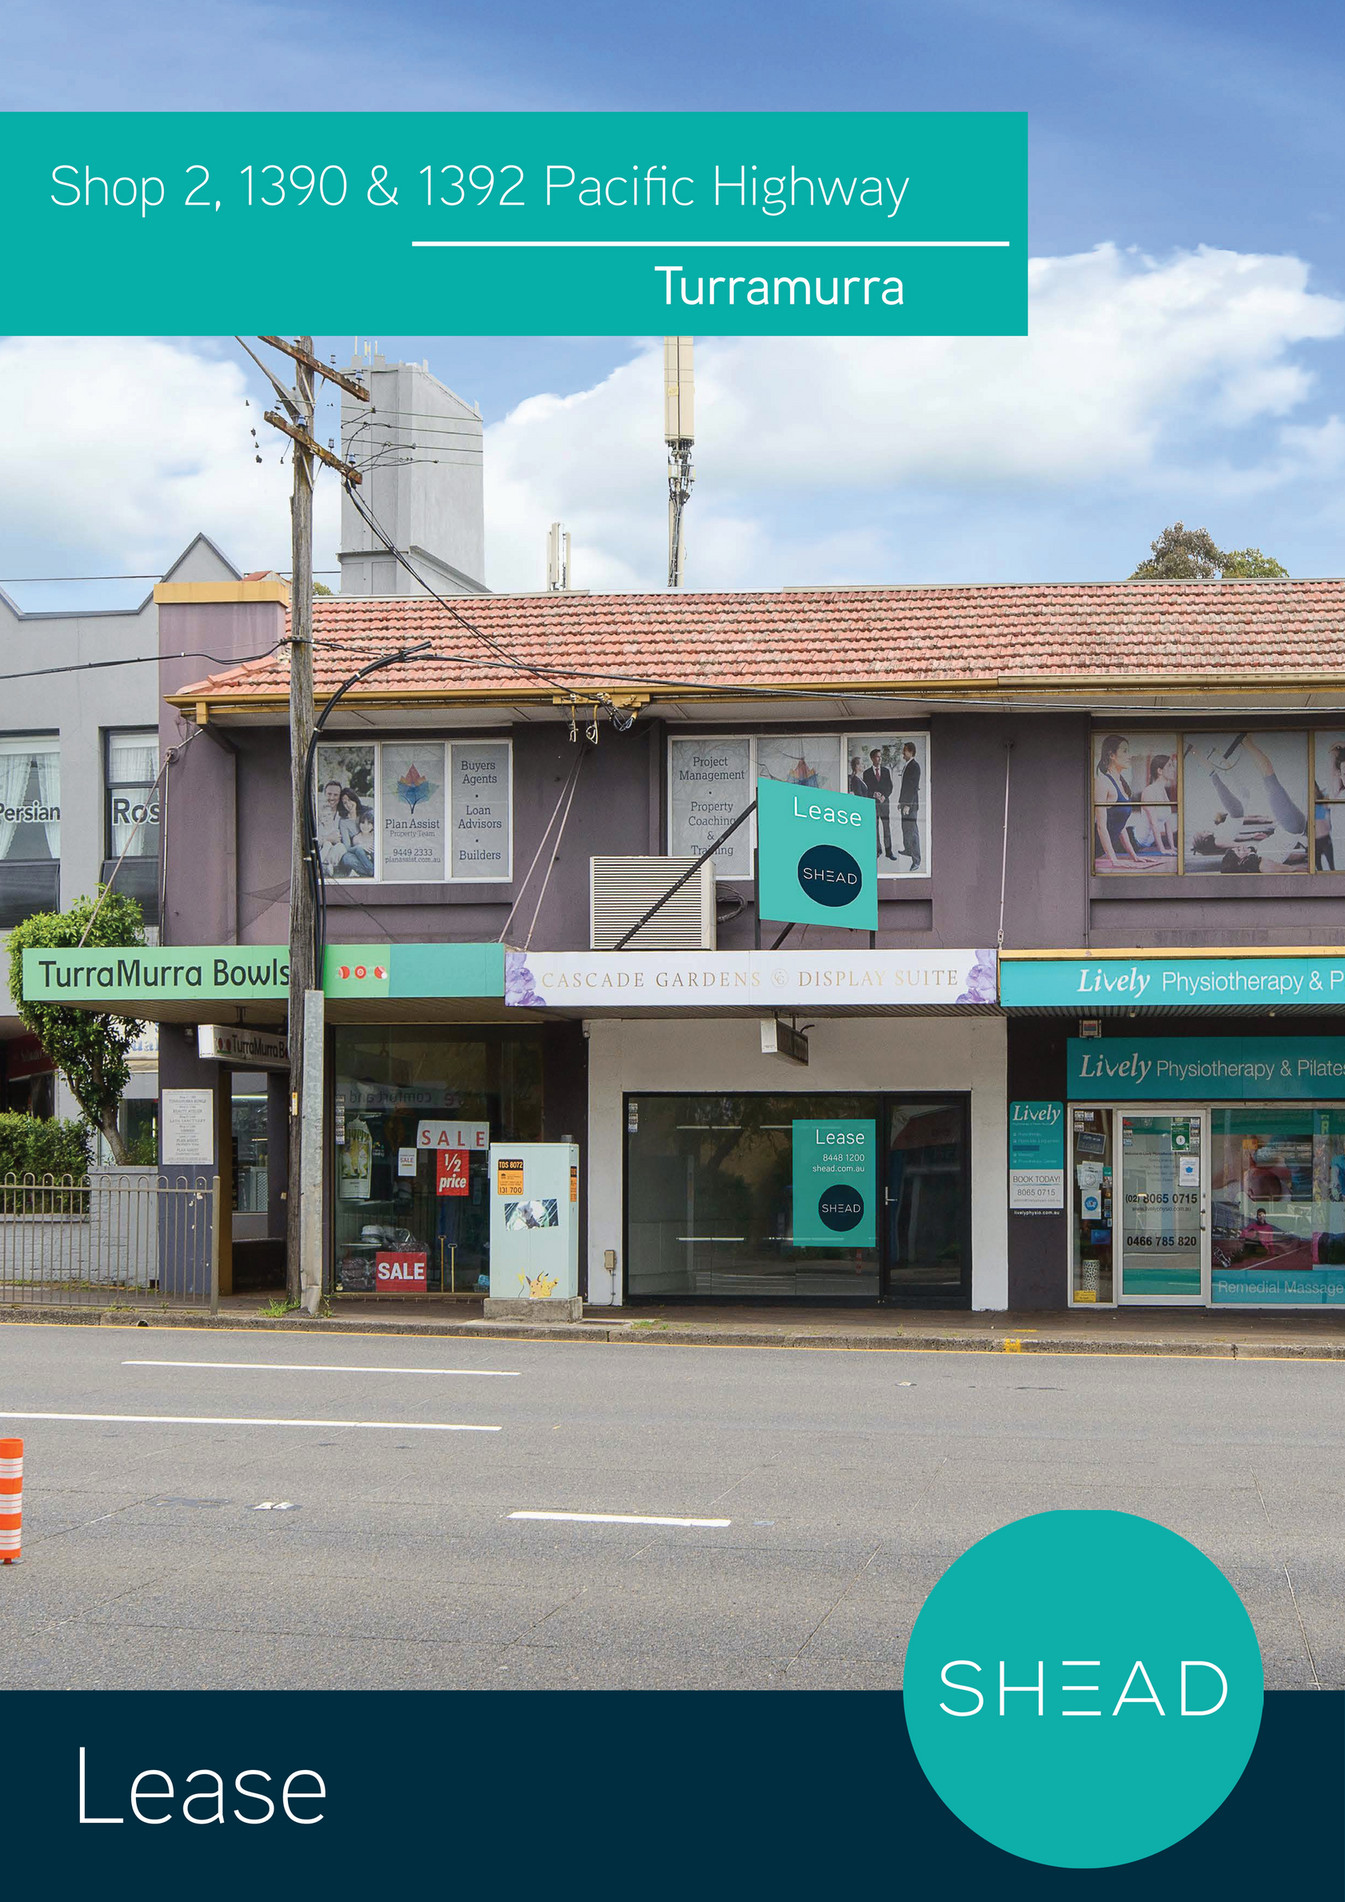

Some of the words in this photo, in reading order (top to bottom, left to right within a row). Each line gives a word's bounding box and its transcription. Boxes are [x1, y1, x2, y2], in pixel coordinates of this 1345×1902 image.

[461, 761, 496, 775] Buyers
[693, 756, 728, 768] Project
[462, 774, 498, 786] Agents
[679, 770, 745, 782] Management
[466, 805, 491, 816] Loan
[691, 801, 734, 814] Property
[794, 796, 862, 827] Lease
[458, 818, 502, 830] Advisors
[707, 831, 714, 840] &
[393, 848, 412, 857] 9449
[414, 848, 432, 857] 2333
[459, 850, 501, 860] Builders
[803, 867, 858, 885] SHEAD
[38, 959, 202, 988] TurraMurra
[214, 958, 290, 987] Bowls
[541, 972, 644, 988] CASCADE
[655, 972, 761, 988] GARDENS
[798, 970, 886, 987] DISPLAY
[894, 970, 958, 986] SUITE
[1077, 966, 1151, 998] Lively
[1162, 970, 1304, 995] Physiotherapy
[1309, 970, 1324, 991] &
[232, 1034, 279, 1058] TurraMurra
[1079, 1053, 1152, 1084] Lively
[1157, 1060, 1276, 1081] Physiotherapy
[1280, 1060, 1292, 1077] &
[1012, 1104, 1061, 1126] Lively
[421, 1130, 486, 1147] SALE
[816, 1128, 864, 1145] Lease
[444, 1153, 462, 1173] 1/2
[822, 1154, 844, 1162] 8448
[846, 1154, 865, 1162] 1200
[812, 1164, 865, 1172] shead.com.au
[438, 1174, 467, 1192] price
[510, 1186, 522, 1194] 700
[1017, 1188, 1036, 1196] 8065
[1037, 1188, 1056, 1196] 0715
[1172, 1194, 1198, 1204] 0715
[822, 1204, 861, 1213] SHEAD
[1126, 1236, 1152, 1246] 0466
[1156, 1236, 1175, 1246] 785
[1178, 1236, 1197, 1246] 820
[378, 1262, 425, 1280] SALE
[1218, 1280, 1280, 1294] Remedial
[1284, 1280, 1344, 1297] Massage
